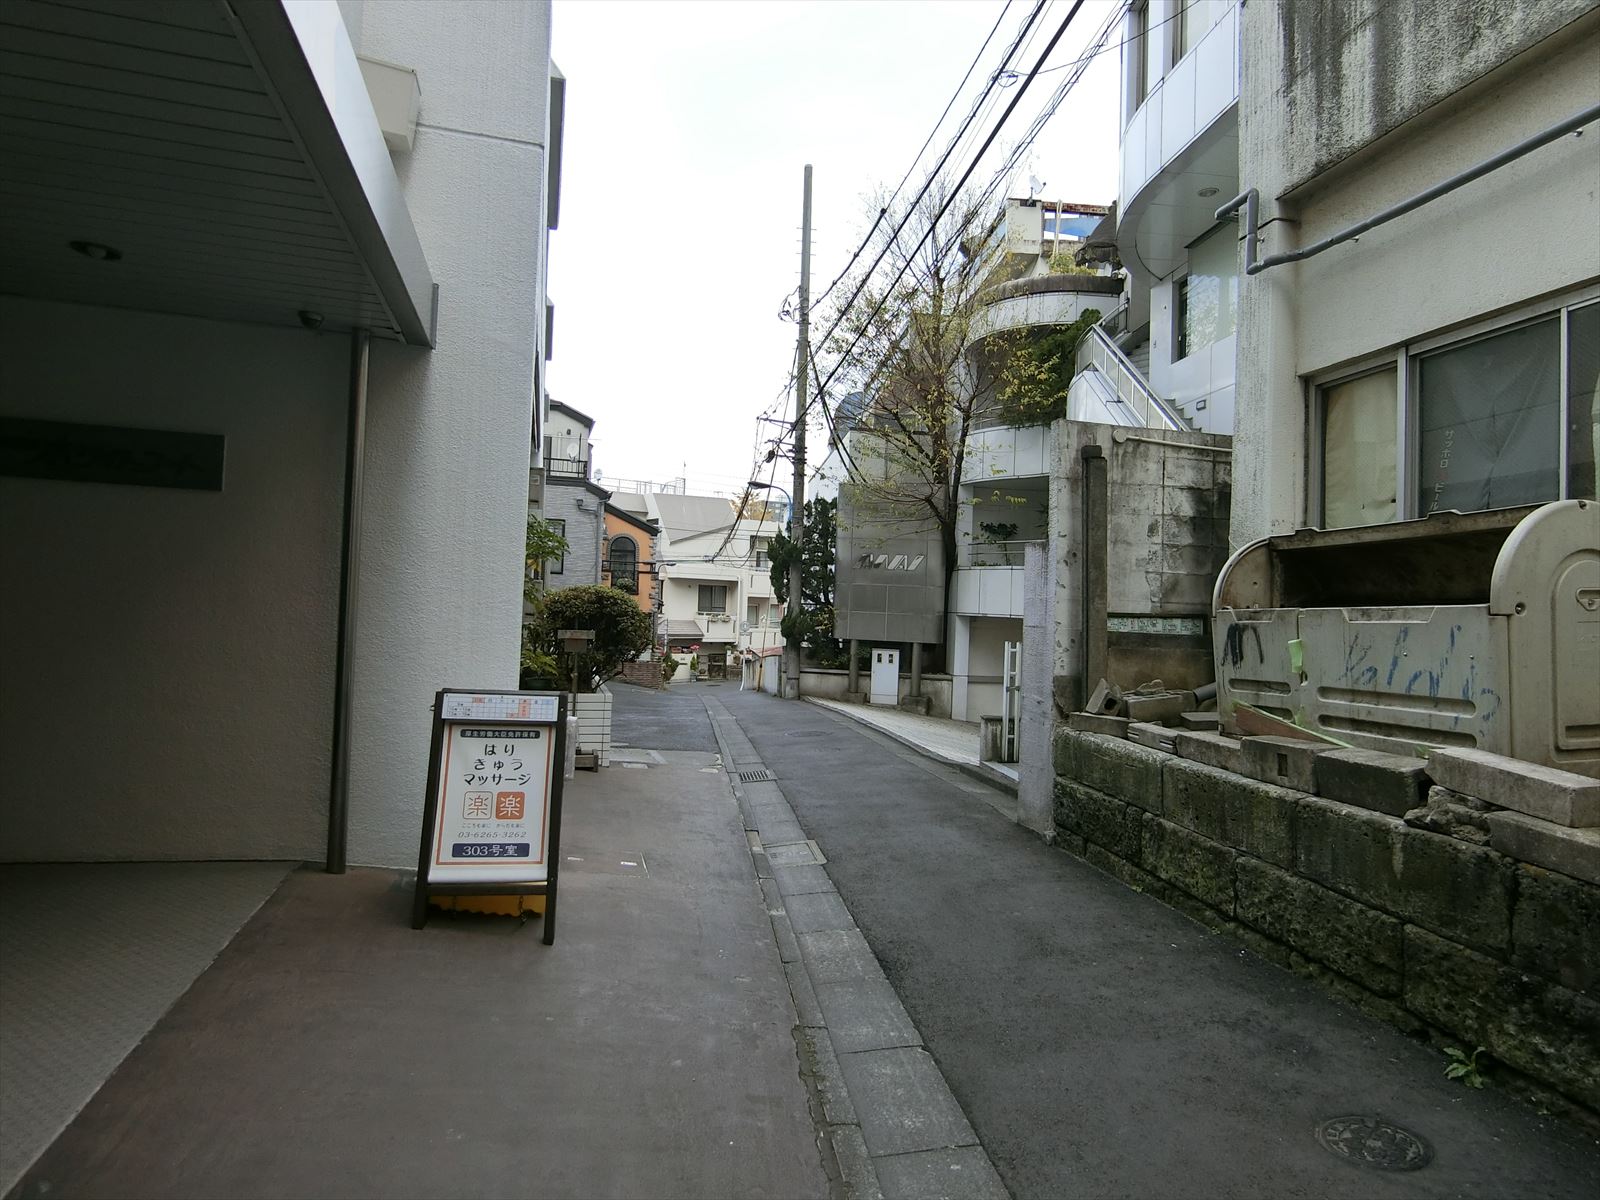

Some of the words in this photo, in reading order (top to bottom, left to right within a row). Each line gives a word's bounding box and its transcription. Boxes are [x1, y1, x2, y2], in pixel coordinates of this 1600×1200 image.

[484, 743, 515, 757] はり
[473, 758, 523, 771] きゅう
[463, 773, 531, 786] マッサージ
[466, 794, 490, 817] 楽
[498, 794, 522, 817] 楽
[457, 831, 527, 839] 03-6265-3262
[462, 844, 519, 857] 303号室
